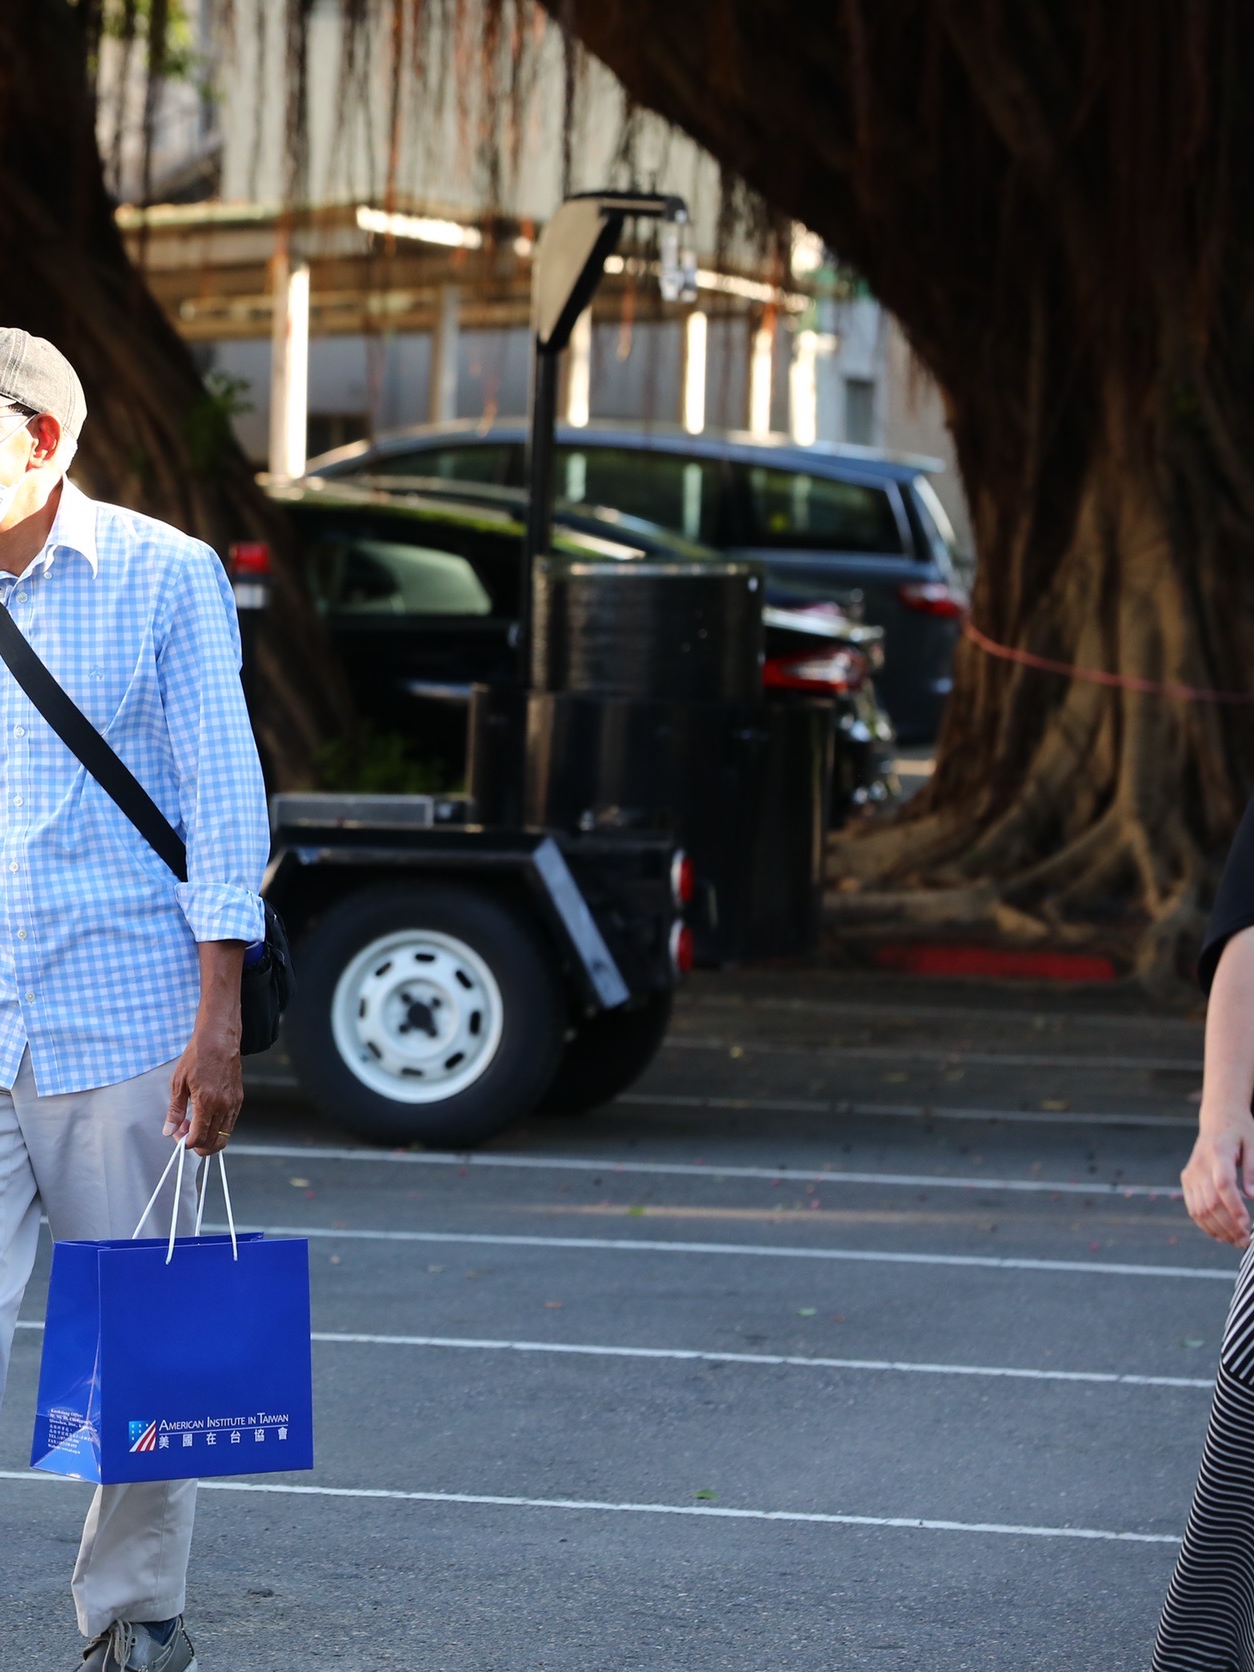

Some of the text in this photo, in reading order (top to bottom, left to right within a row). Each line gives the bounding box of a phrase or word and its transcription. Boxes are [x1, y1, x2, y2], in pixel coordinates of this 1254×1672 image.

[158, 1412, 289, 1431] AMERICAN INSTITUTE IN TAIWAN
[158, 1426, 288, 1449] 美國在台協會
